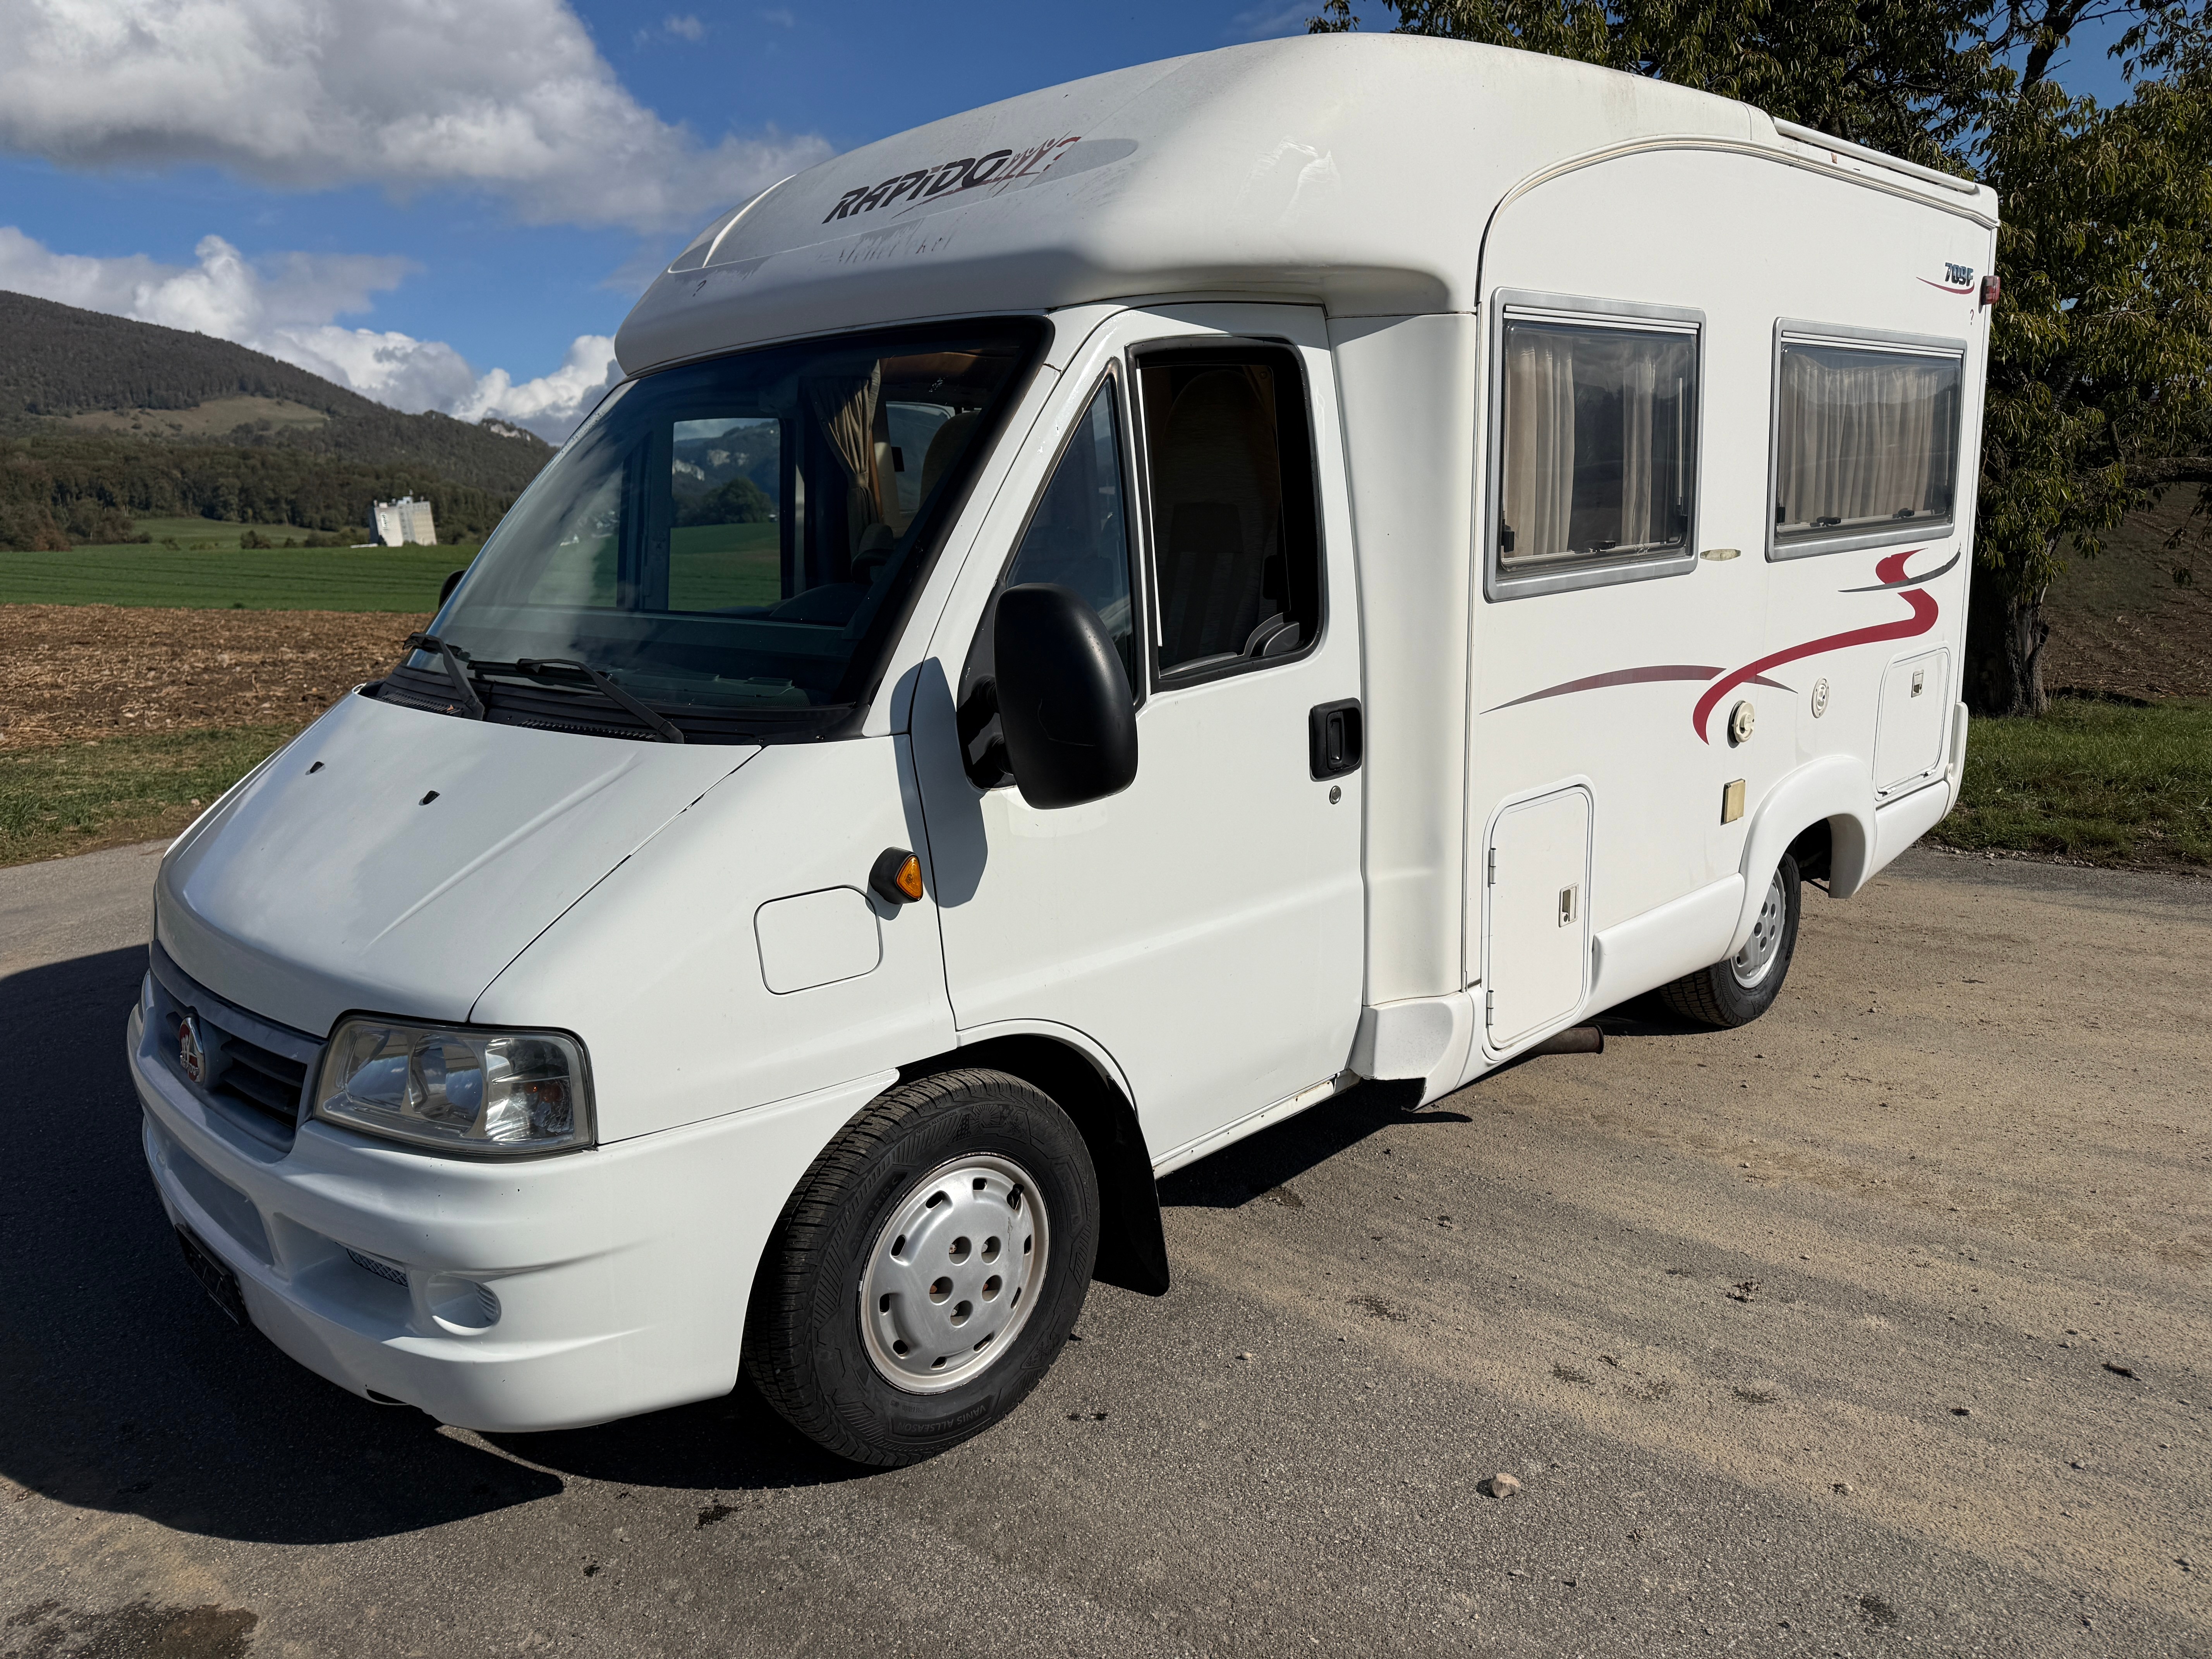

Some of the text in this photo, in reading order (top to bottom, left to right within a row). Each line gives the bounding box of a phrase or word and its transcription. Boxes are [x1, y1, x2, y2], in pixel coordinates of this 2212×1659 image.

[1945, 262, 1974, 287] 709F
[917, 1111, 957, 1134] VANIS ALLSEASON
[896, 1405, 986, 1433] VANIS ALLSEASON
